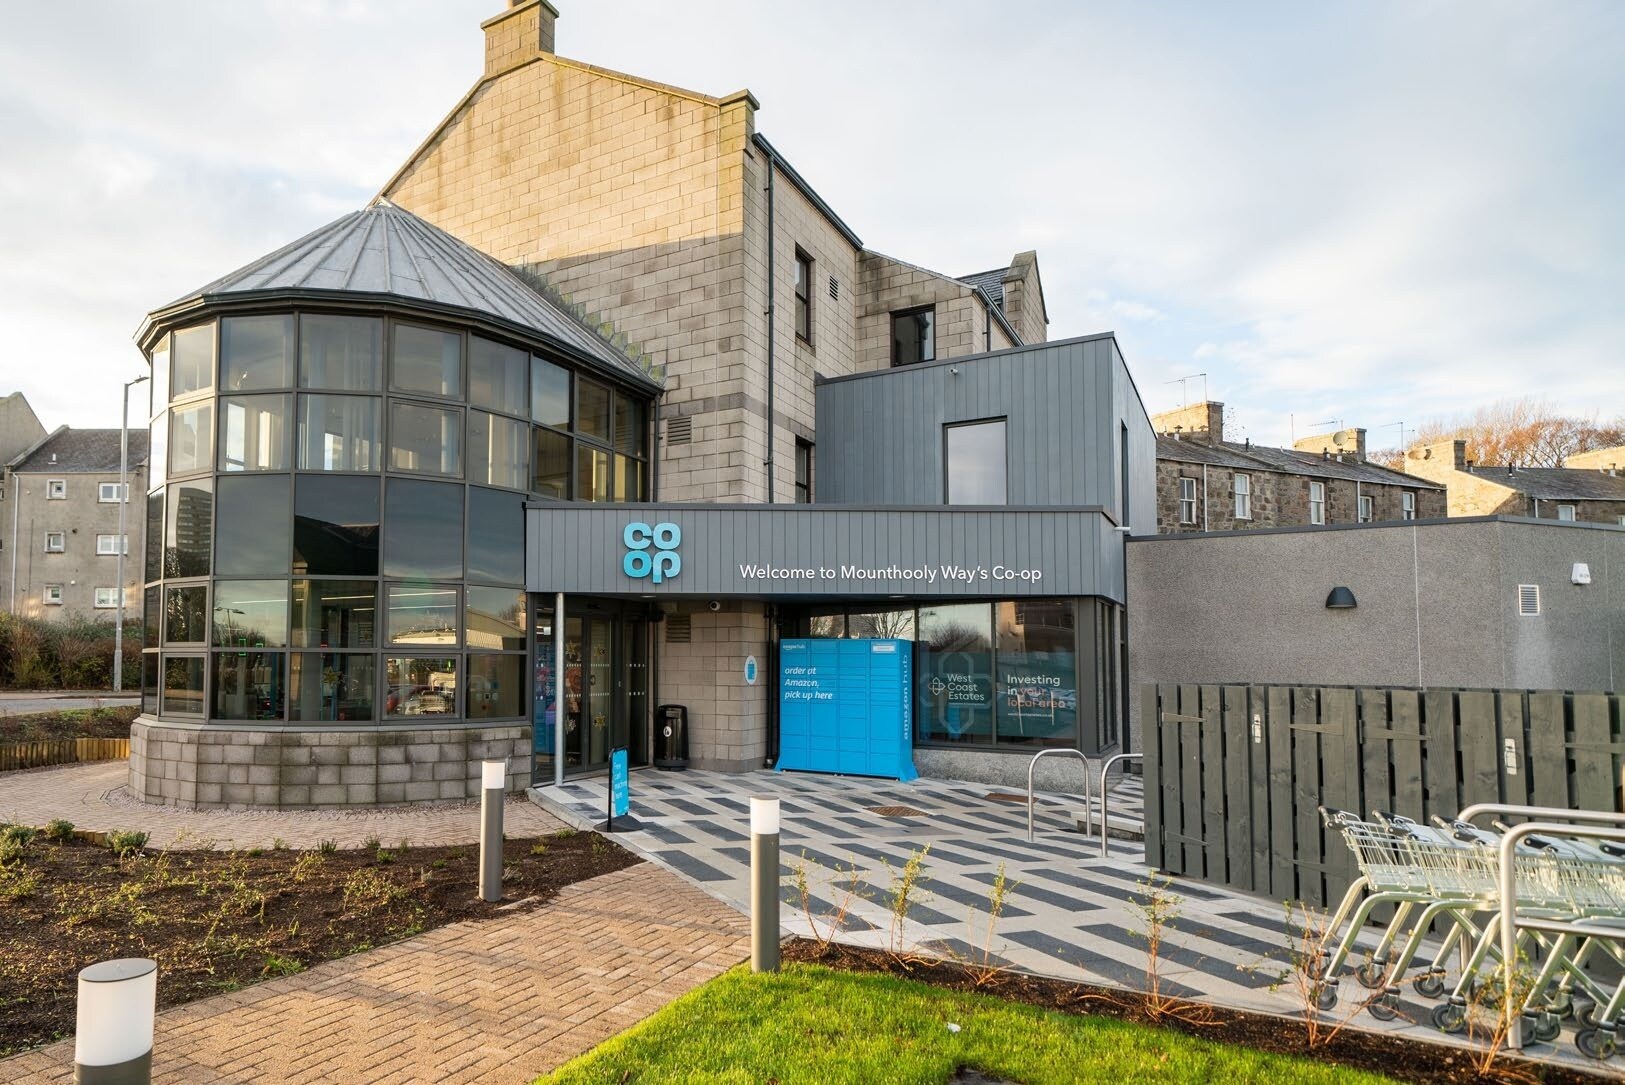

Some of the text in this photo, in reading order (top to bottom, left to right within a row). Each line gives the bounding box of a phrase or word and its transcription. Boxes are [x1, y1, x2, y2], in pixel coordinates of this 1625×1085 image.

[739, 564, 1042, 583] Welcome to Mounthooly Way's Co-op
[784, 667, 817, 675] order at
[947, 674, 972, 682] West
[1007, 674, 1061, 686] Investing
[784, 679, 819, 688] Amazon,
[947, 683, 978, 692] Coast
[784, 691, 833, 700] pick up here
[948, 692, 985, 701] Estates
[1007, 688, 1047, 698] in your
[1039, 700, 1066, 708] area
